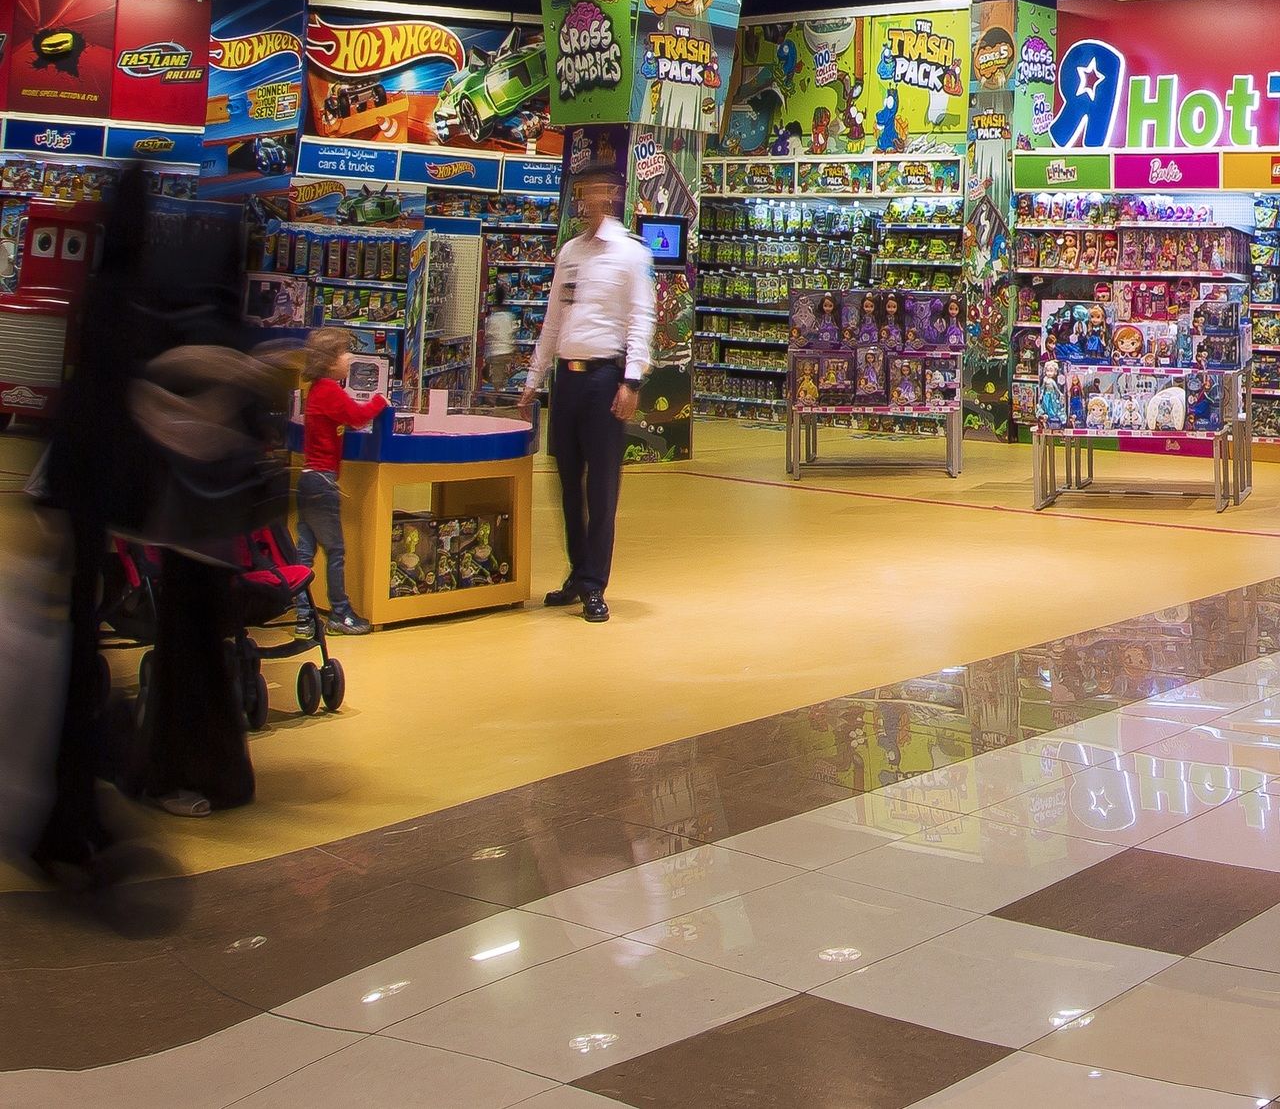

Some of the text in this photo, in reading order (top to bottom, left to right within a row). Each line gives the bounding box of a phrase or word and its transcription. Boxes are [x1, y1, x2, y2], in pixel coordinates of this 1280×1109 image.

[675, 26, 691, 37] THE
[916, 21, 932, 33] THE
[560, 20, 614, 52] GROSS
[650, 34, 711, 63] TRASH
[889, 30, 954, 64] TRASH
[1021, 45, 1053, 65] GROSS
[813, 49, 830, 68] 100
[165, 69, 203, 81] RACING
[557, 44, 622, 94] ZOMBIES
[658, 58, 705, 84] PACK
[894, 58, 944, 90] PACK
[257, 83, 291, 98] CONNECT
[260, 96, 276, 107] YOUR
[973, 115, 1005, 128] TRASH
[977, 128, 1002, 139] PACK
[634, 140, 656, 160] 100
[318, 162, 375, 174] cars & trucks
[637, 155, 665, 171] COLLECT
[1149, 158, 1183, 184] Barbie
[523, 174, 542, 184] cars
[543, 175, 553, 185] &
